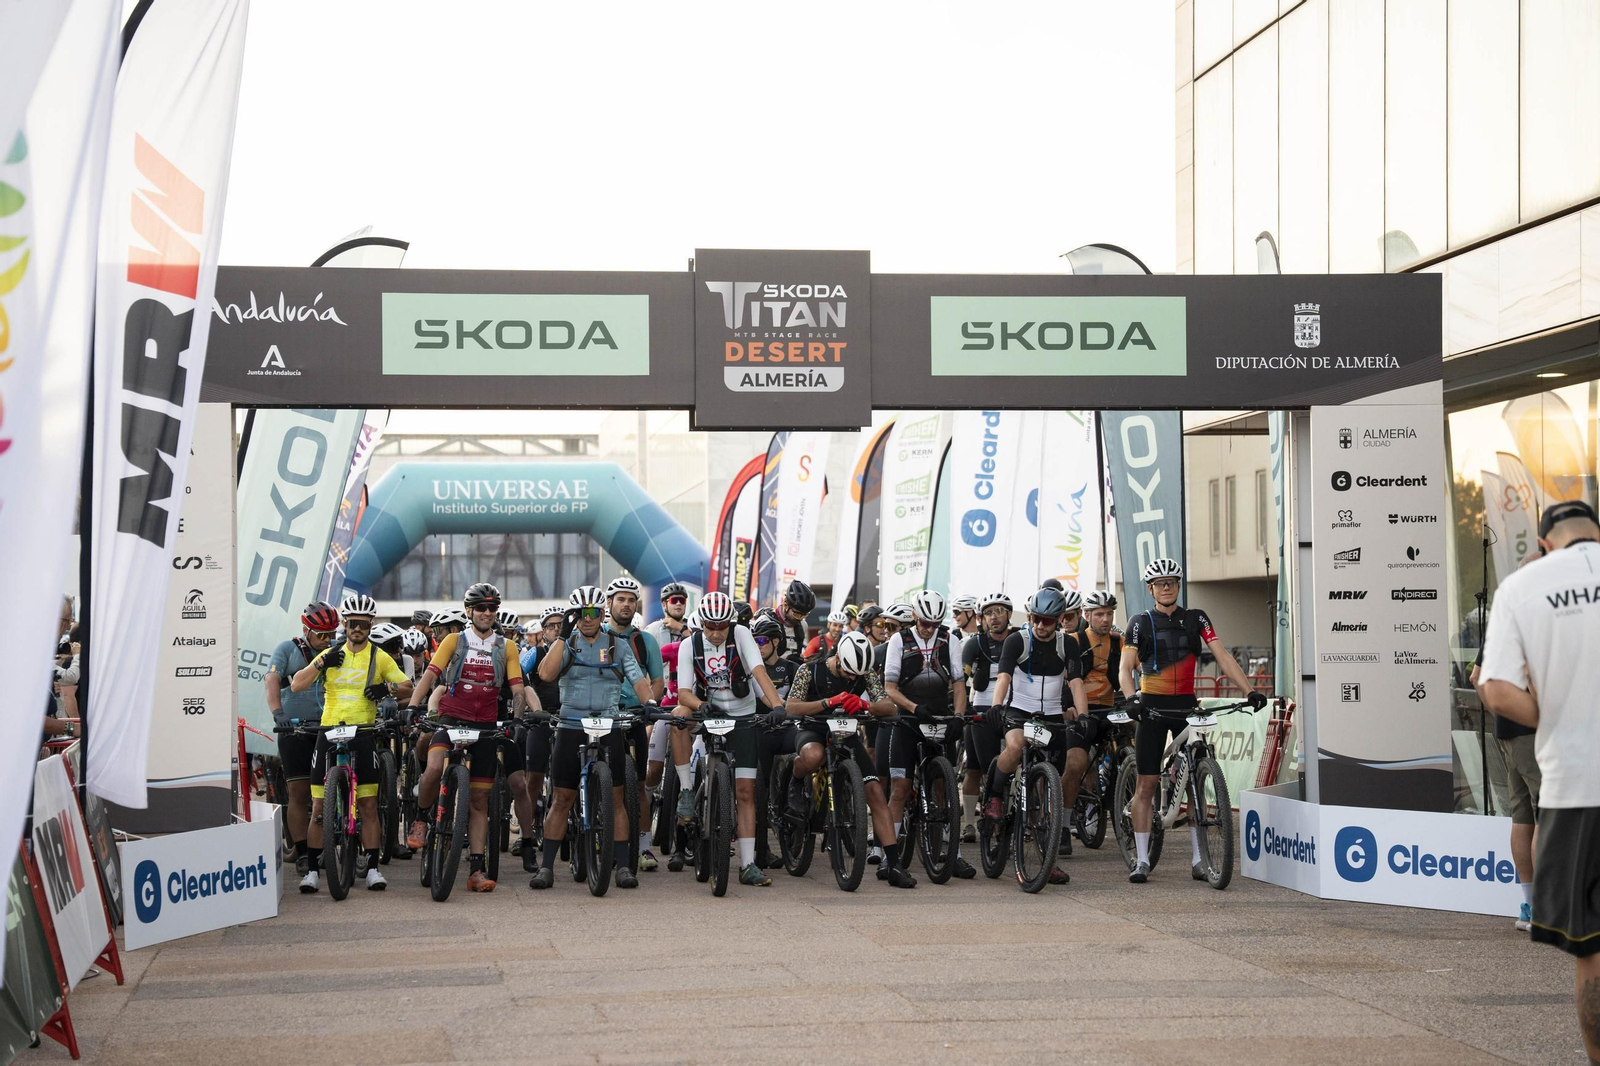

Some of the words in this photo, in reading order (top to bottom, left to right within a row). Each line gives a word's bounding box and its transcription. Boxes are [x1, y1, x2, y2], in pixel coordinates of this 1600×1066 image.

[705, 281, 847, 330] TITAN
[117, 131, 205, 549] MRW
[725, 341, 848, 362] DESERT
[1215, 353, 1307, 369] DIPUTACIÓN
[1312, 356, 1331, 369] DE
[1335, 353, 1400, 369] ALMERÍA
[740, 369, 828, 388] ALMERÍA
[1363, 426, 1417, 439] ALMERÍA
[432, 479, 589, 500] UNIVERSAE
[1356, 475, 1428, 487] Cleardent
[433, 502, 487, 514] Instituto
[491, 502, 547, 516] Superior
[550, 502, 567, 514] de
[571, 503, 588, 514] FP
[1332, 521, 1361, 529] primaflor
[1329, 590, 1368, 600] MRW
[1343, 685, 1351, 700] RAC
[1352, 685, 1359, 700] 1
[1264, 826, 1316, 865] Cleardent
[167, 855, 267, 904] Cleardent
